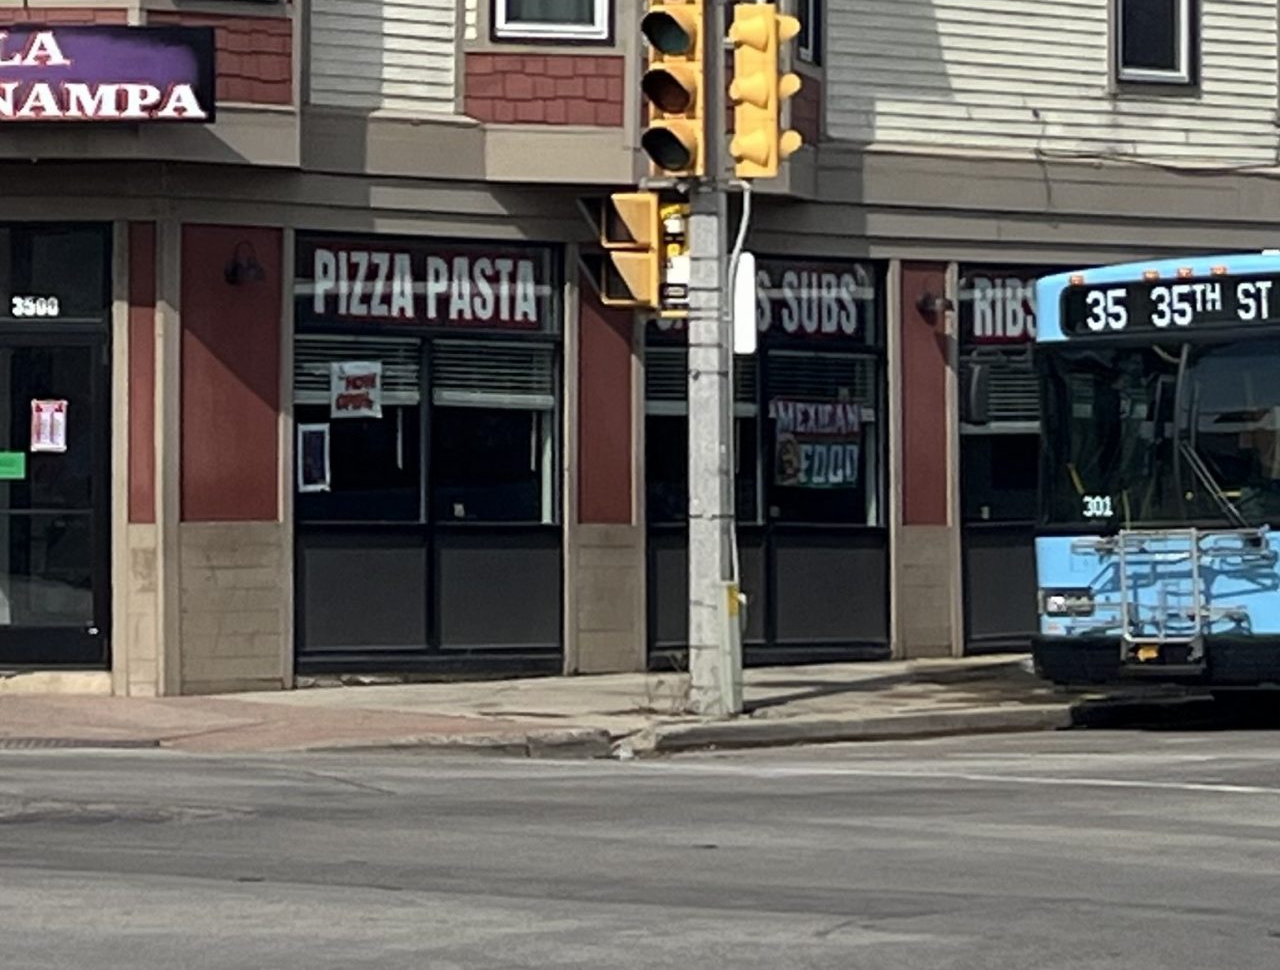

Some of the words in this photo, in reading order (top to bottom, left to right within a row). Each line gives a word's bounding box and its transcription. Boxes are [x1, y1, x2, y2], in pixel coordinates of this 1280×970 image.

[314, 248, 414, 318] PIZZA
[426, 256, 537, 322] PASTA
[781, 270, 857, 334] SUBS
[1086, 287, 1128, 332] 35
[1150, 282, 1222, 328] 35TH
[1236, 280, 1273, 321] ST
[1082, 495, 1114, 517] 301
